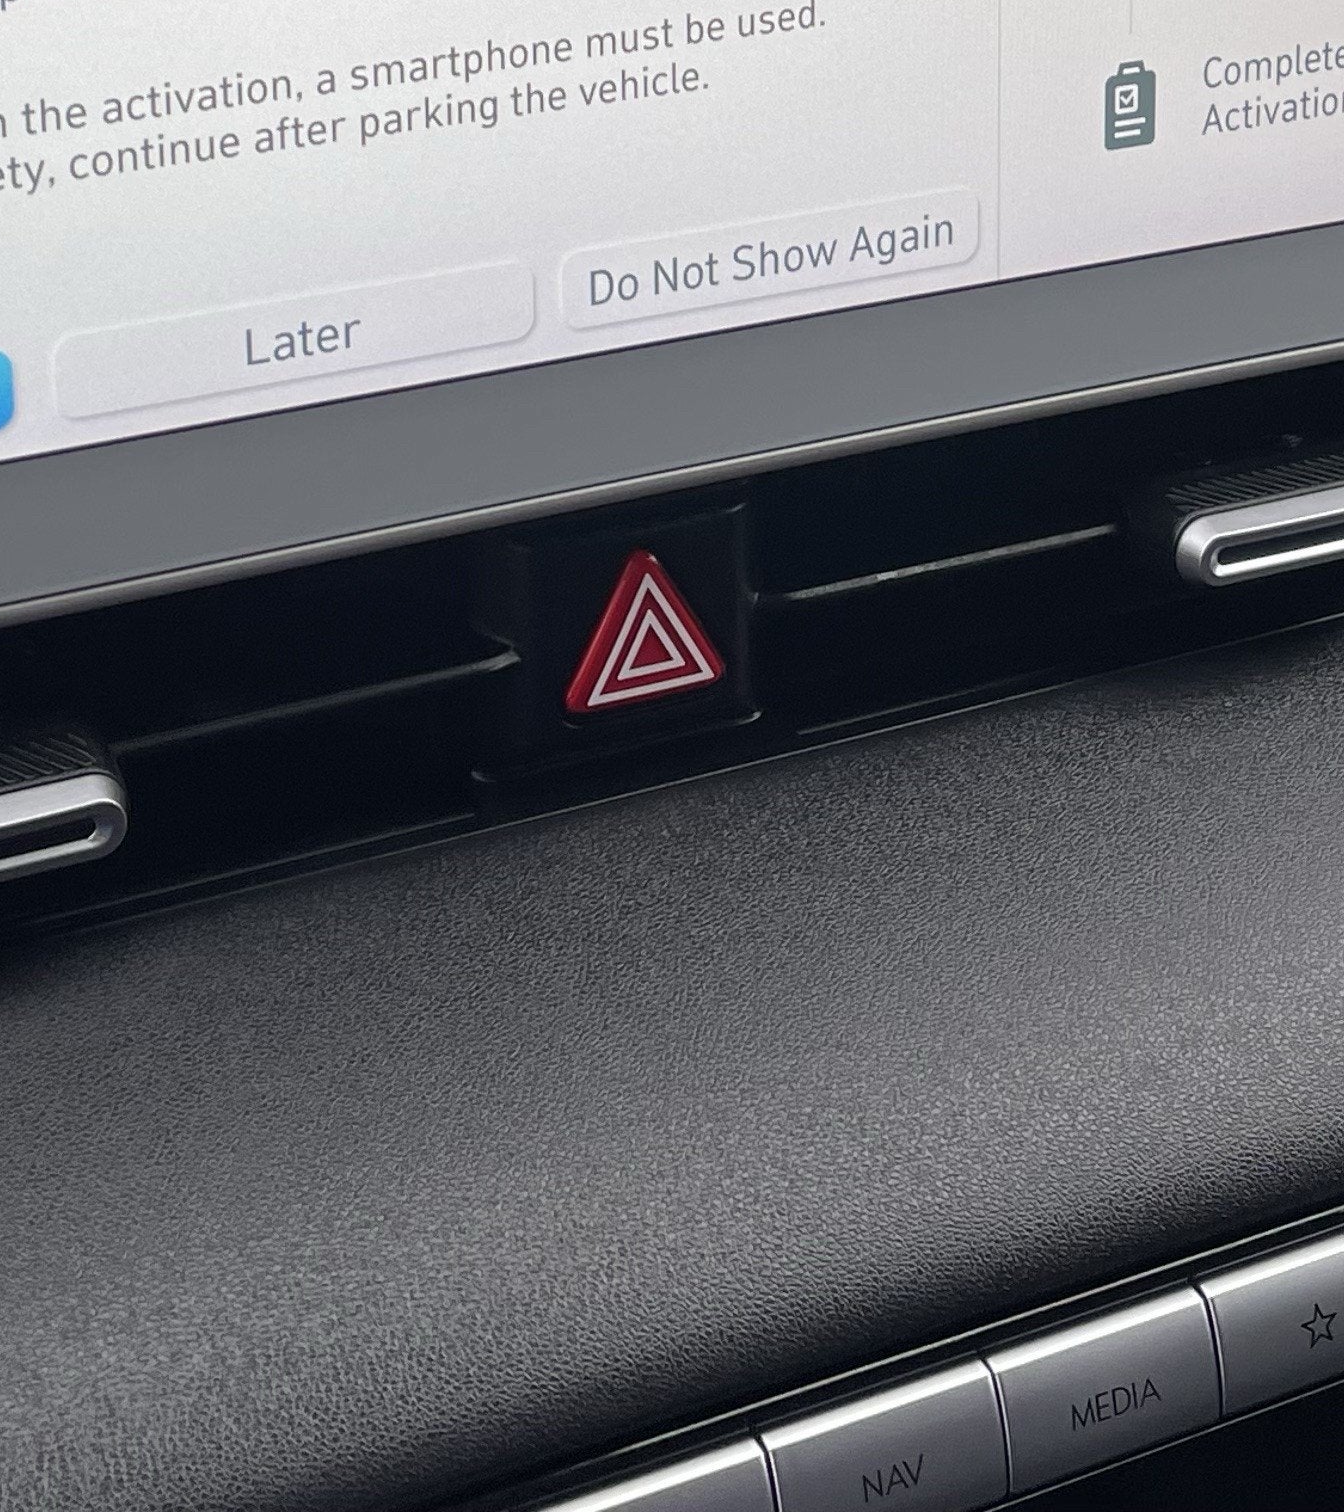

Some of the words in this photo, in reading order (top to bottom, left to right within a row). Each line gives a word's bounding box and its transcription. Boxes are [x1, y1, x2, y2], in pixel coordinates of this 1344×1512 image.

[20, 97, 88, 136] the
[102, 71, 303, 125] activation,
[316, 69, 337, 96] a
[350, 37, 573, 91] smartphone
[586, 18, 674, 59] must
[685, 12, 726, 45] be
[69, 132, 241, 181] continue
[254, 115, 347, 154] after
[360, 92, 499, 147] parking
[509, 82, 567, 117] the
[578, 61, 709, 106] vehicle.
[589, 268, 640, 307] Do
[653, 252, 720, 296] Not
[732, 239, 838, 282] Show
[849, 213, 954, 266] Again
[245, 319, 362, 366] Later
[1070, 1377, 1162, 1431] MEDIA
[861, 1453, 924, 1503] NAV
